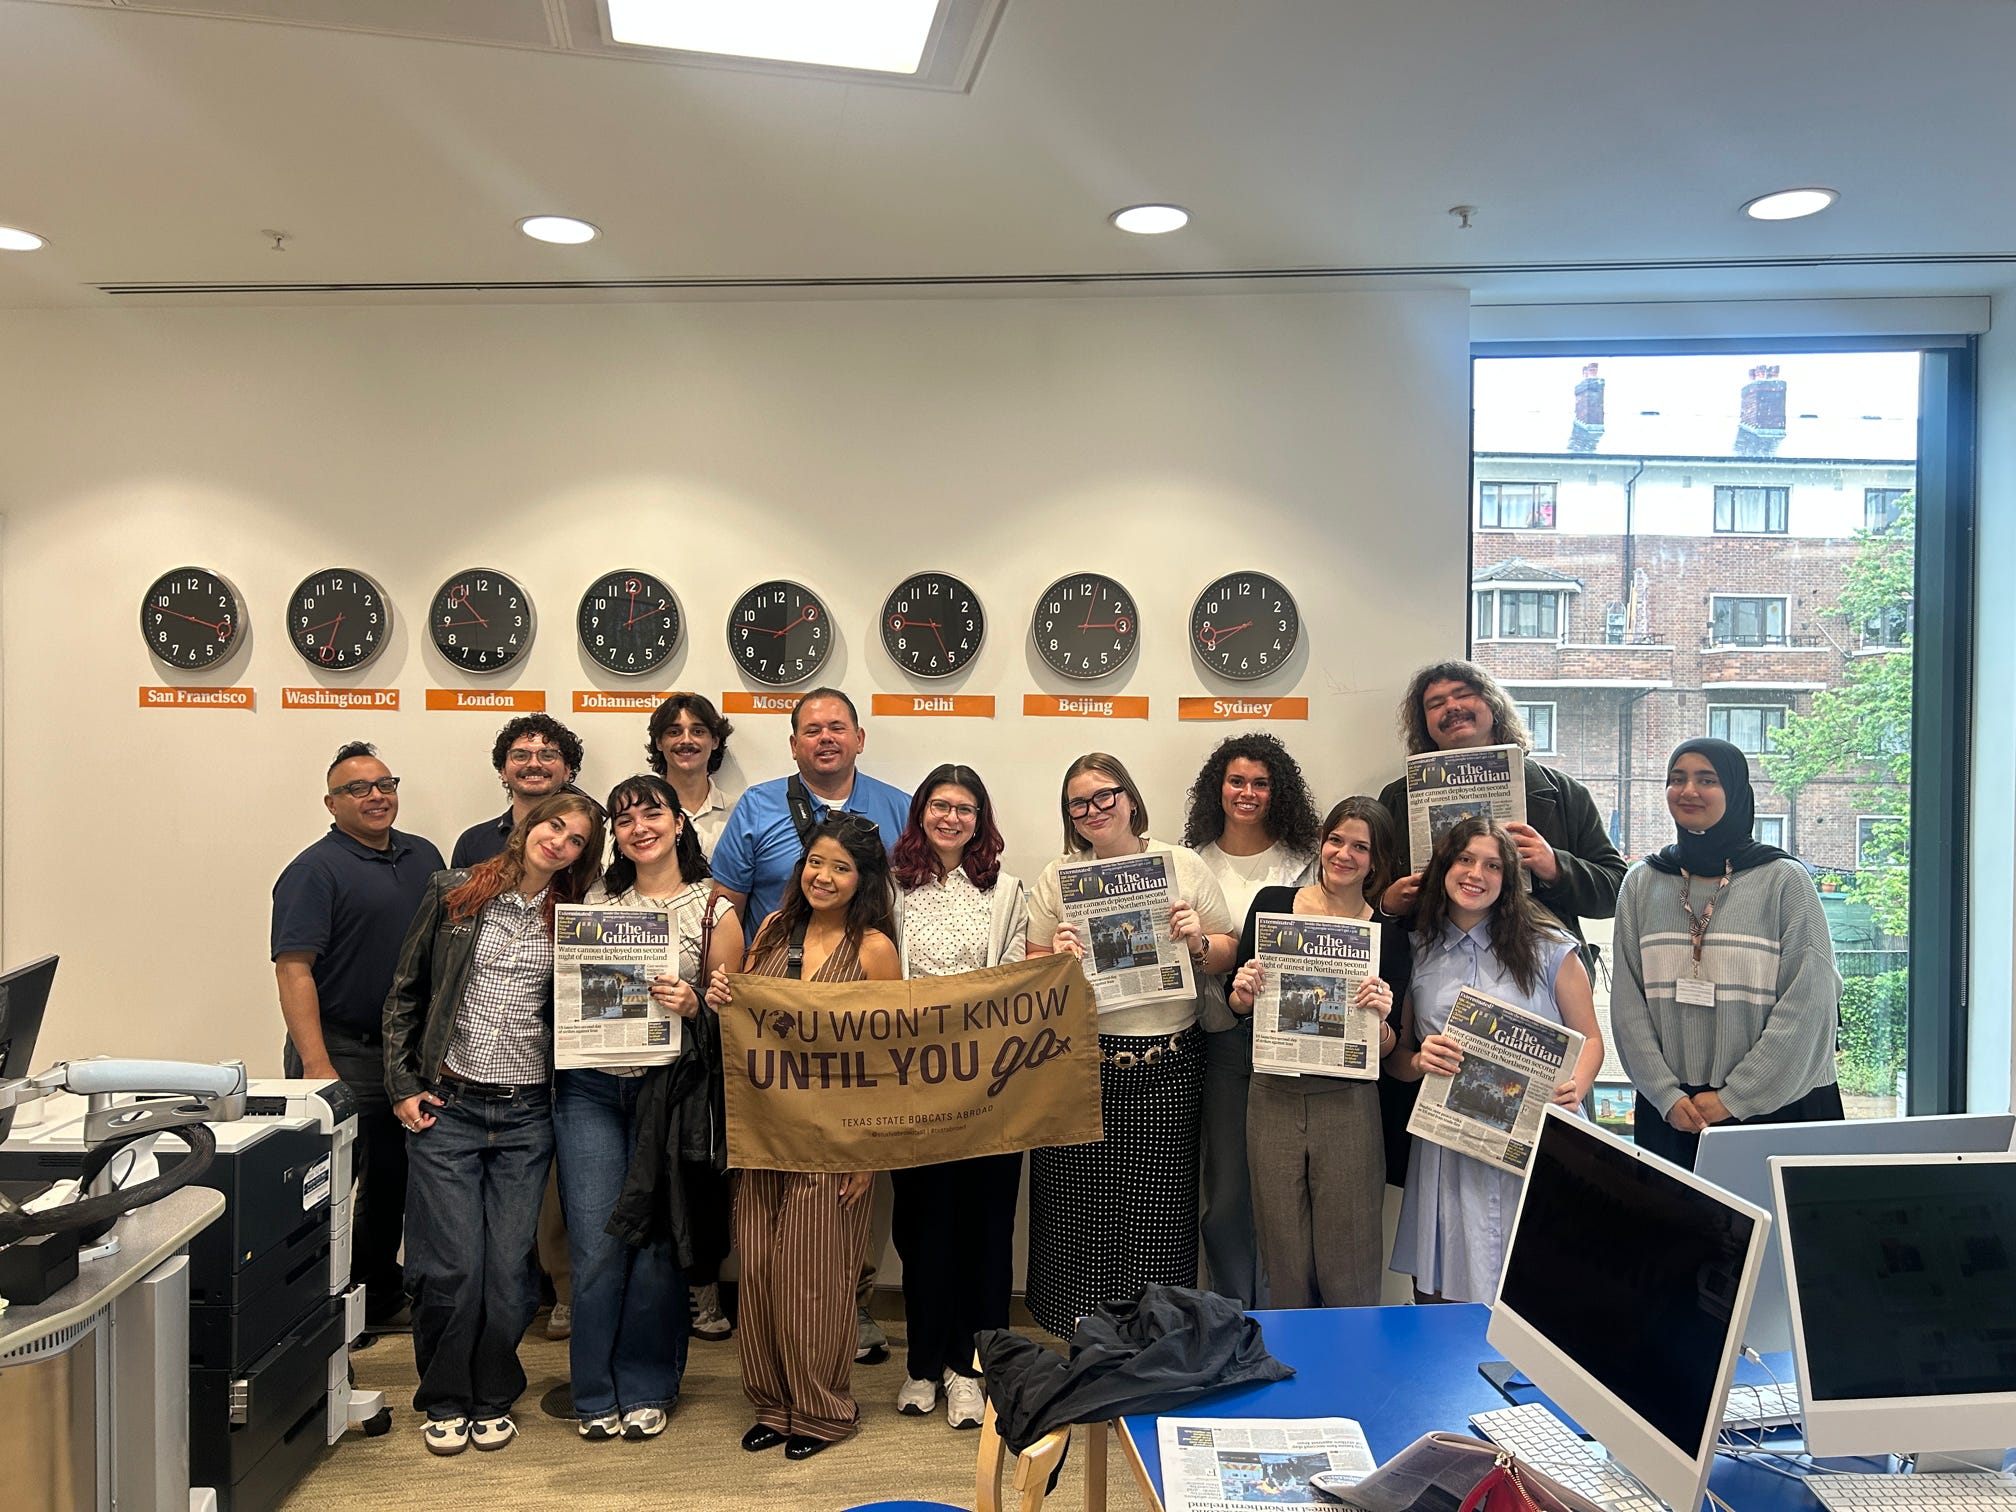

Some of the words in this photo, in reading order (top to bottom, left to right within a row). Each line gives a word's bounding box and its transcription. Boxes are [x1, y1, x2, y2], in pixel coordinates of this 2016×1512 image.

[187, 578, 199, 590] 12
[332, 578, 343, 591] 12
[477, 579, 488, 591] 12
[928, 583, 939, 595] 12
[1080, 583, 1092, 596] 12
[1238, 583, 1251, 596] 12
[159, 595, 169, 607] 10
[219, 596, 226, 608] 2
[304, 598, 315, 610] 10
[364, 594, 372, 606] 2
[509, 597, 517, 609] 2
[595, 598, 606, 610] 10
[774, 591, 786, 604] 12
[897, 601, 908, 613] 10
[961, 601, 969, 613] 2
[1049, 602, 1061, 614] 10
[1114, 601, 1122, 614] 2
[1207, 602, 1218, 615] 10
[1273, 600, 1282, 613] 2
[155, 613, 163, 625] 9
[301, 616, 309, 627] 9
[370, 612, 377, 624] 3
[514, 615, 522, 627] 3
[591, 616, 599, 629] 9
[744, 610, 756, 622] 10
[663, 617, 671, 629] 3
[966, 619, 974, 632] 3
[1045, 620, 1053, 633] 9
[1278, 619, 1287, 632] 3
[159, 631, 168, 643] 8
[306, 633, 315, 645] 8
[365, 630, 373, 642] 4
[448, 633, 457, 645] 8
[509, 633, 517, 645] 4
[741, 628, 749, 640] 9
[812, 627, 821, 639] 3
[595, 634, 605, 646] 8
[657, 635, 666, 647] 4
[898, 638, 907, 650] 8
[960, 638, 969, 650] 4
[1049, 638, 1059, 651] 8
[1113, 638, 1121, 651] 4
[1272, 638, 1281, 651] 4
[172, 644, 179, 656] 7
[189, 648, 196, 661] 6
[206, 644, 214, 656] 5
[337, 649, 345, 661] 6
[354, 644, 362, 656] 5
[461, 646, 469, 659] 7
[497, 646, 504, 658] 5
[609, 648, 617, 660] 7
[645, 648, 653, 660] 5
[746, 646, 755, 658] 8
[808, 645, 816, 657] 4
[479, 651, 487, 663] 6
[627, 652, 635, 665] 6
[911, 651, 919, 663] 7
[930, 655, 937, 668] 6
[1063, 652, 1072, 665] 7
[1082, 657, 1090, 669] 6
[1100, 652, 1108, 665] 5
[1221, 652, 1230, 665] 7
[1240, 657, 1249, 669] 6
[1259, 652, 1268, 665] 5
[759, 659, 767, 672] 7
[778, 663, 786, 676] 6
[796, 658, 804, 671] 5
[148, 690, 174, 703] San
[177, 690, 246, 704] Francisco
[286, 690, 372, 707] Washington
[374, 692, 396, 705] DC
[457, 693, 514, 707] London
[581, 694, 667, 708] Johannesb
[753, 696, 800, 709] Mosco
[913, 698, 954, 711] Delhi
[1058, 699, 1113, 715] Beijing
[1213, 701, 1272, 716] Sydney
[1457, 763, 1483, 775] The
[1446, 770, 1510, 785] Guardian
[1448, 786, 1476, 795] deployed
[1458, 792, 1488, 800] Northern
[1488, 790, 1511, 798] Ireland
[1114, 871, 1140, 885] The
[1104, 876, 1166, 896] Guardian
[1106, 896, 1135, 906] deployed
[1144, 890, 1167, 899] second
[1065, 910, 1083, 918] night
[1118, 901, 1147, 911] Northern
[1147, 897, 1169, 907] Ireland
[615, 922, 642, 935] The
[602, 931, 669, 944] Guardian
[1316, 934, 1343, 947] The
[602, 947, 632, 955] deployed
[1303, 942, 1370, 960] Guardian
[558, 954, 575, 962] night
[1278, 956, 1303, 964] cannon
[1303, 957, 1333, 967] deployed
[1343, 961, 1368, 969] second
[1259, 961, 1276, 969] night
[1284, 964, 1305, 972] unrest
[1313, 966, 1344, 975] Northern
[1344, 968, 1369, 976] Ireland
[829, 1004, 952, 1042] WON'T
[963, 984, 1070, 1031] KNOW
[1511, 1025, 1538, 1045] The
[1447, 1026, 1465, 1038] Water
[1465, 1034, 1490, 1049] cannon
[1490, 1043, 1524, 1061] deployed
[1522, 1055, 1531, 1065] on
[1529, 1059, 1556, 1074] second
[1494, 1029, 1563, 1066] Guardian
[748, 1049, 878, 1090] UNTIL
[888, 1040, 978, 1086] YOU
[987, 1027, 1064, 1097] go
[1468, 1045, 1490, 1058] unrest
[1498, 1054, 1531, 1073] Northern
[1529, 1066, 1556, 1082] Ireland
[842, 1117, 872, 1128] TEXAS
[876, 1116, 905, 1126] STATE
[908, 1113, 953, 1124] BOBCATS
[956, 1105, 993, 1119] ABROAD
[1187, 1501, 1229, 1509] Ireland
